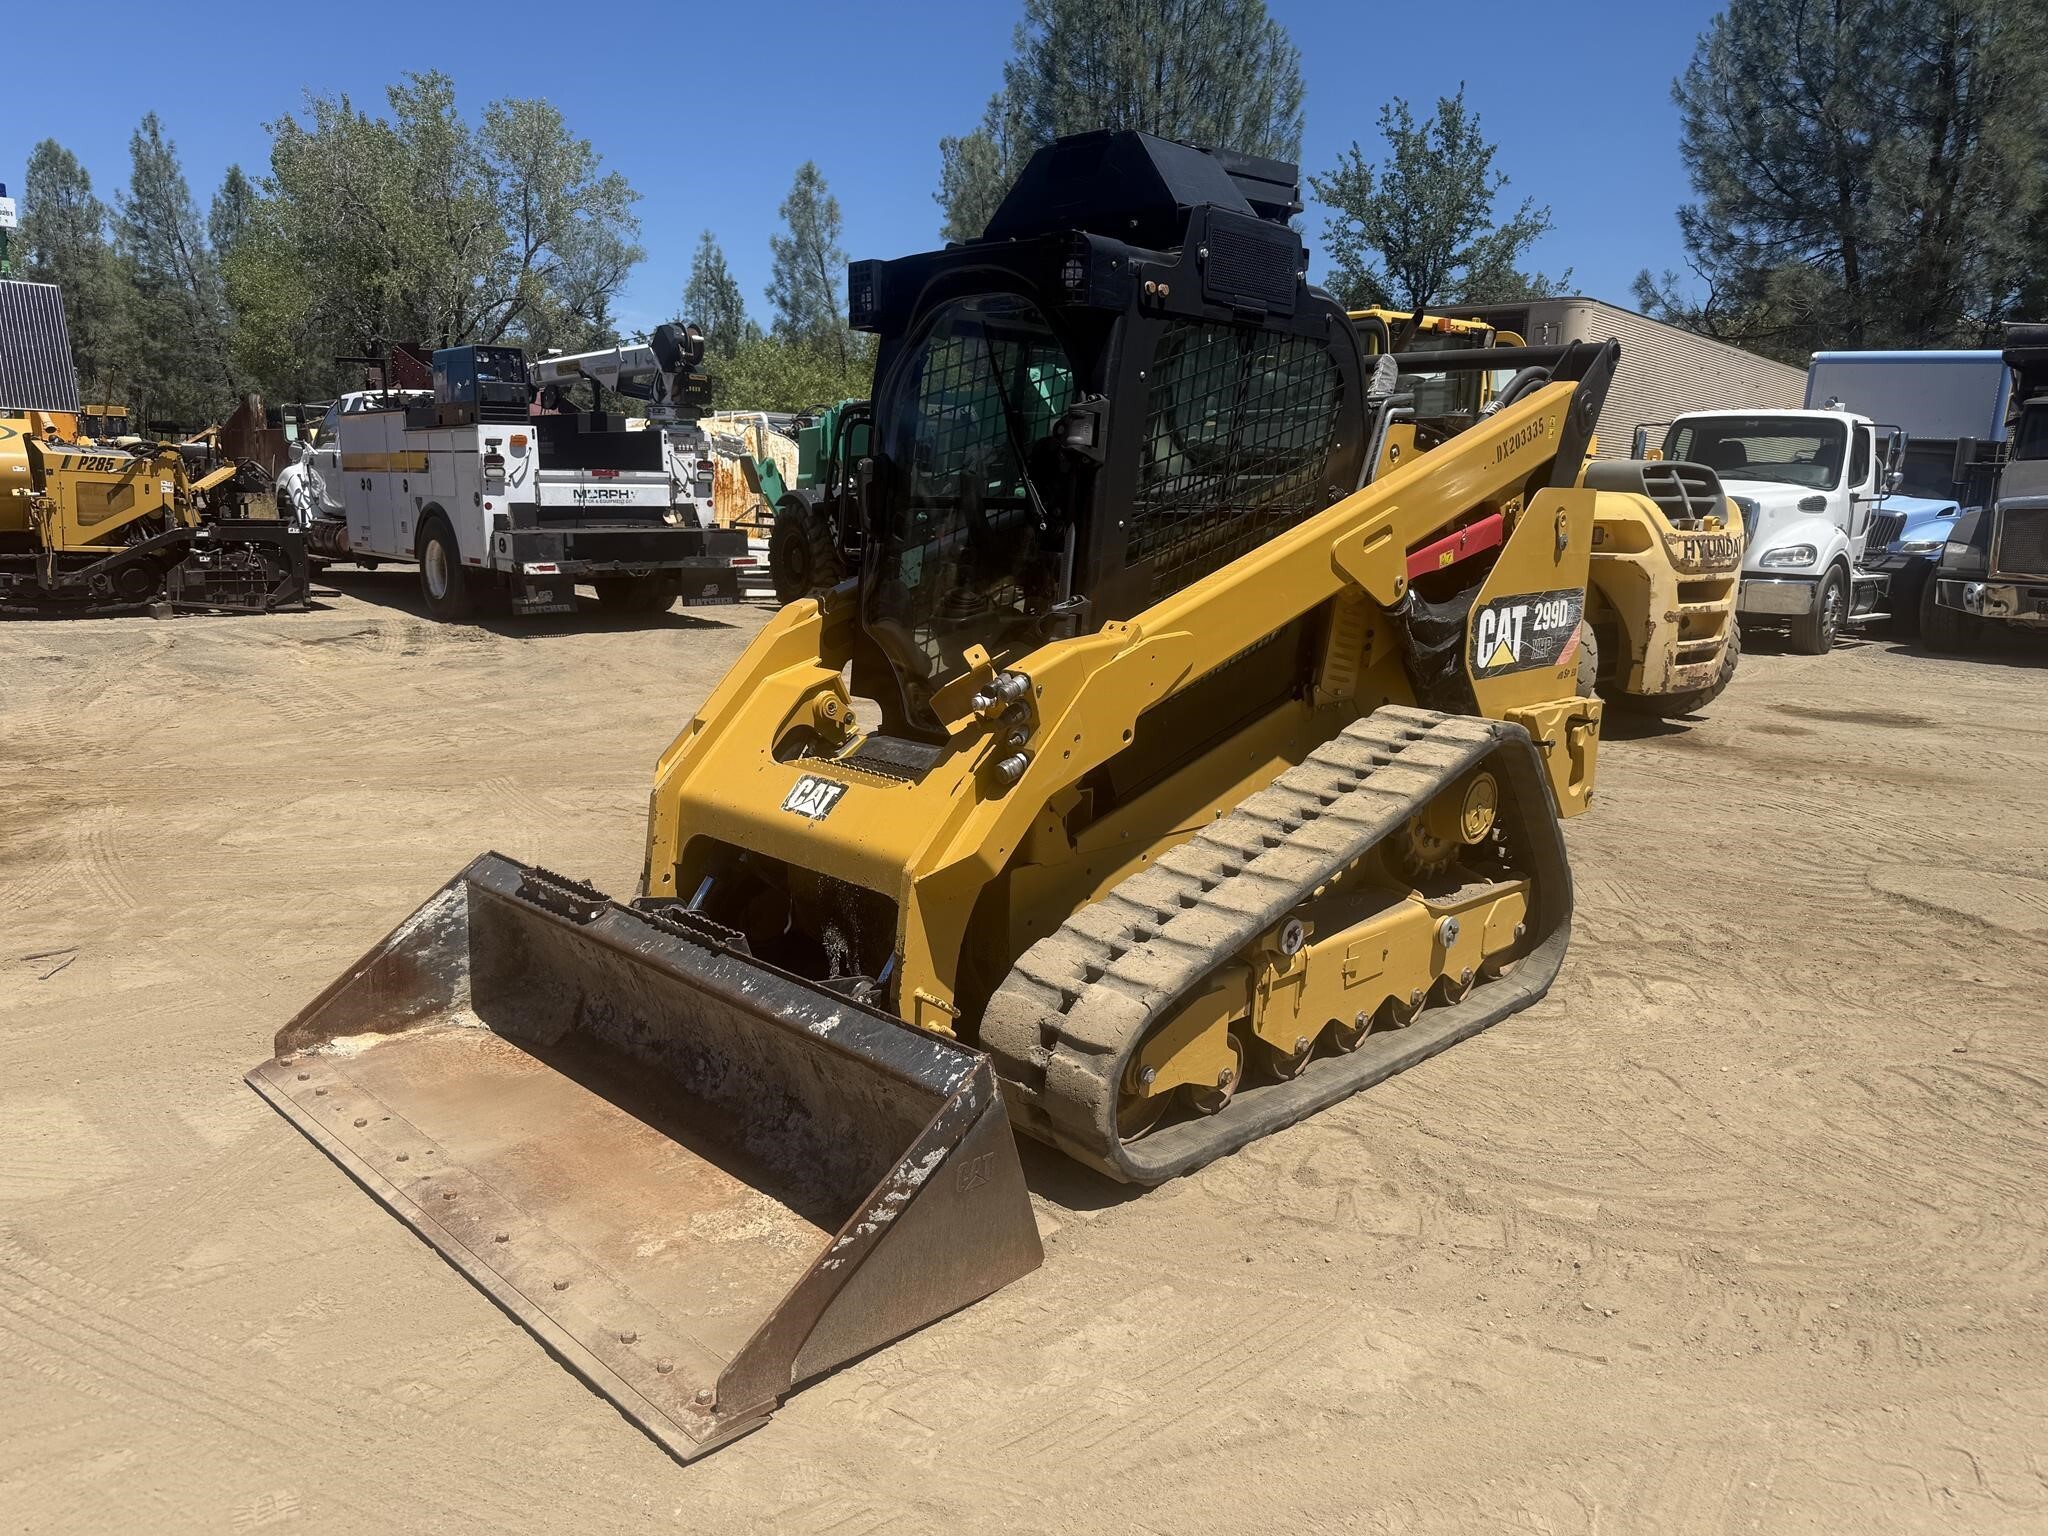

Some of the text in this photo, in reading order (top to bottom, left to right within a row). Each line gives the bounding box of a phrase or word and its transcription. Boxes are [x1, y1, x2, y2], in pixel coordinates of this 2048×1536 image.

[1496, 417, 1544, 463] DX203335
[78, 457, 115, 471] P285
[1684, 538, 1741, 559] HYUNDAI
[1477, 605, 1528, 669] CAT
[787, 779, 842, 817] CAT
[956, 1152, 994, 1192] CAT
